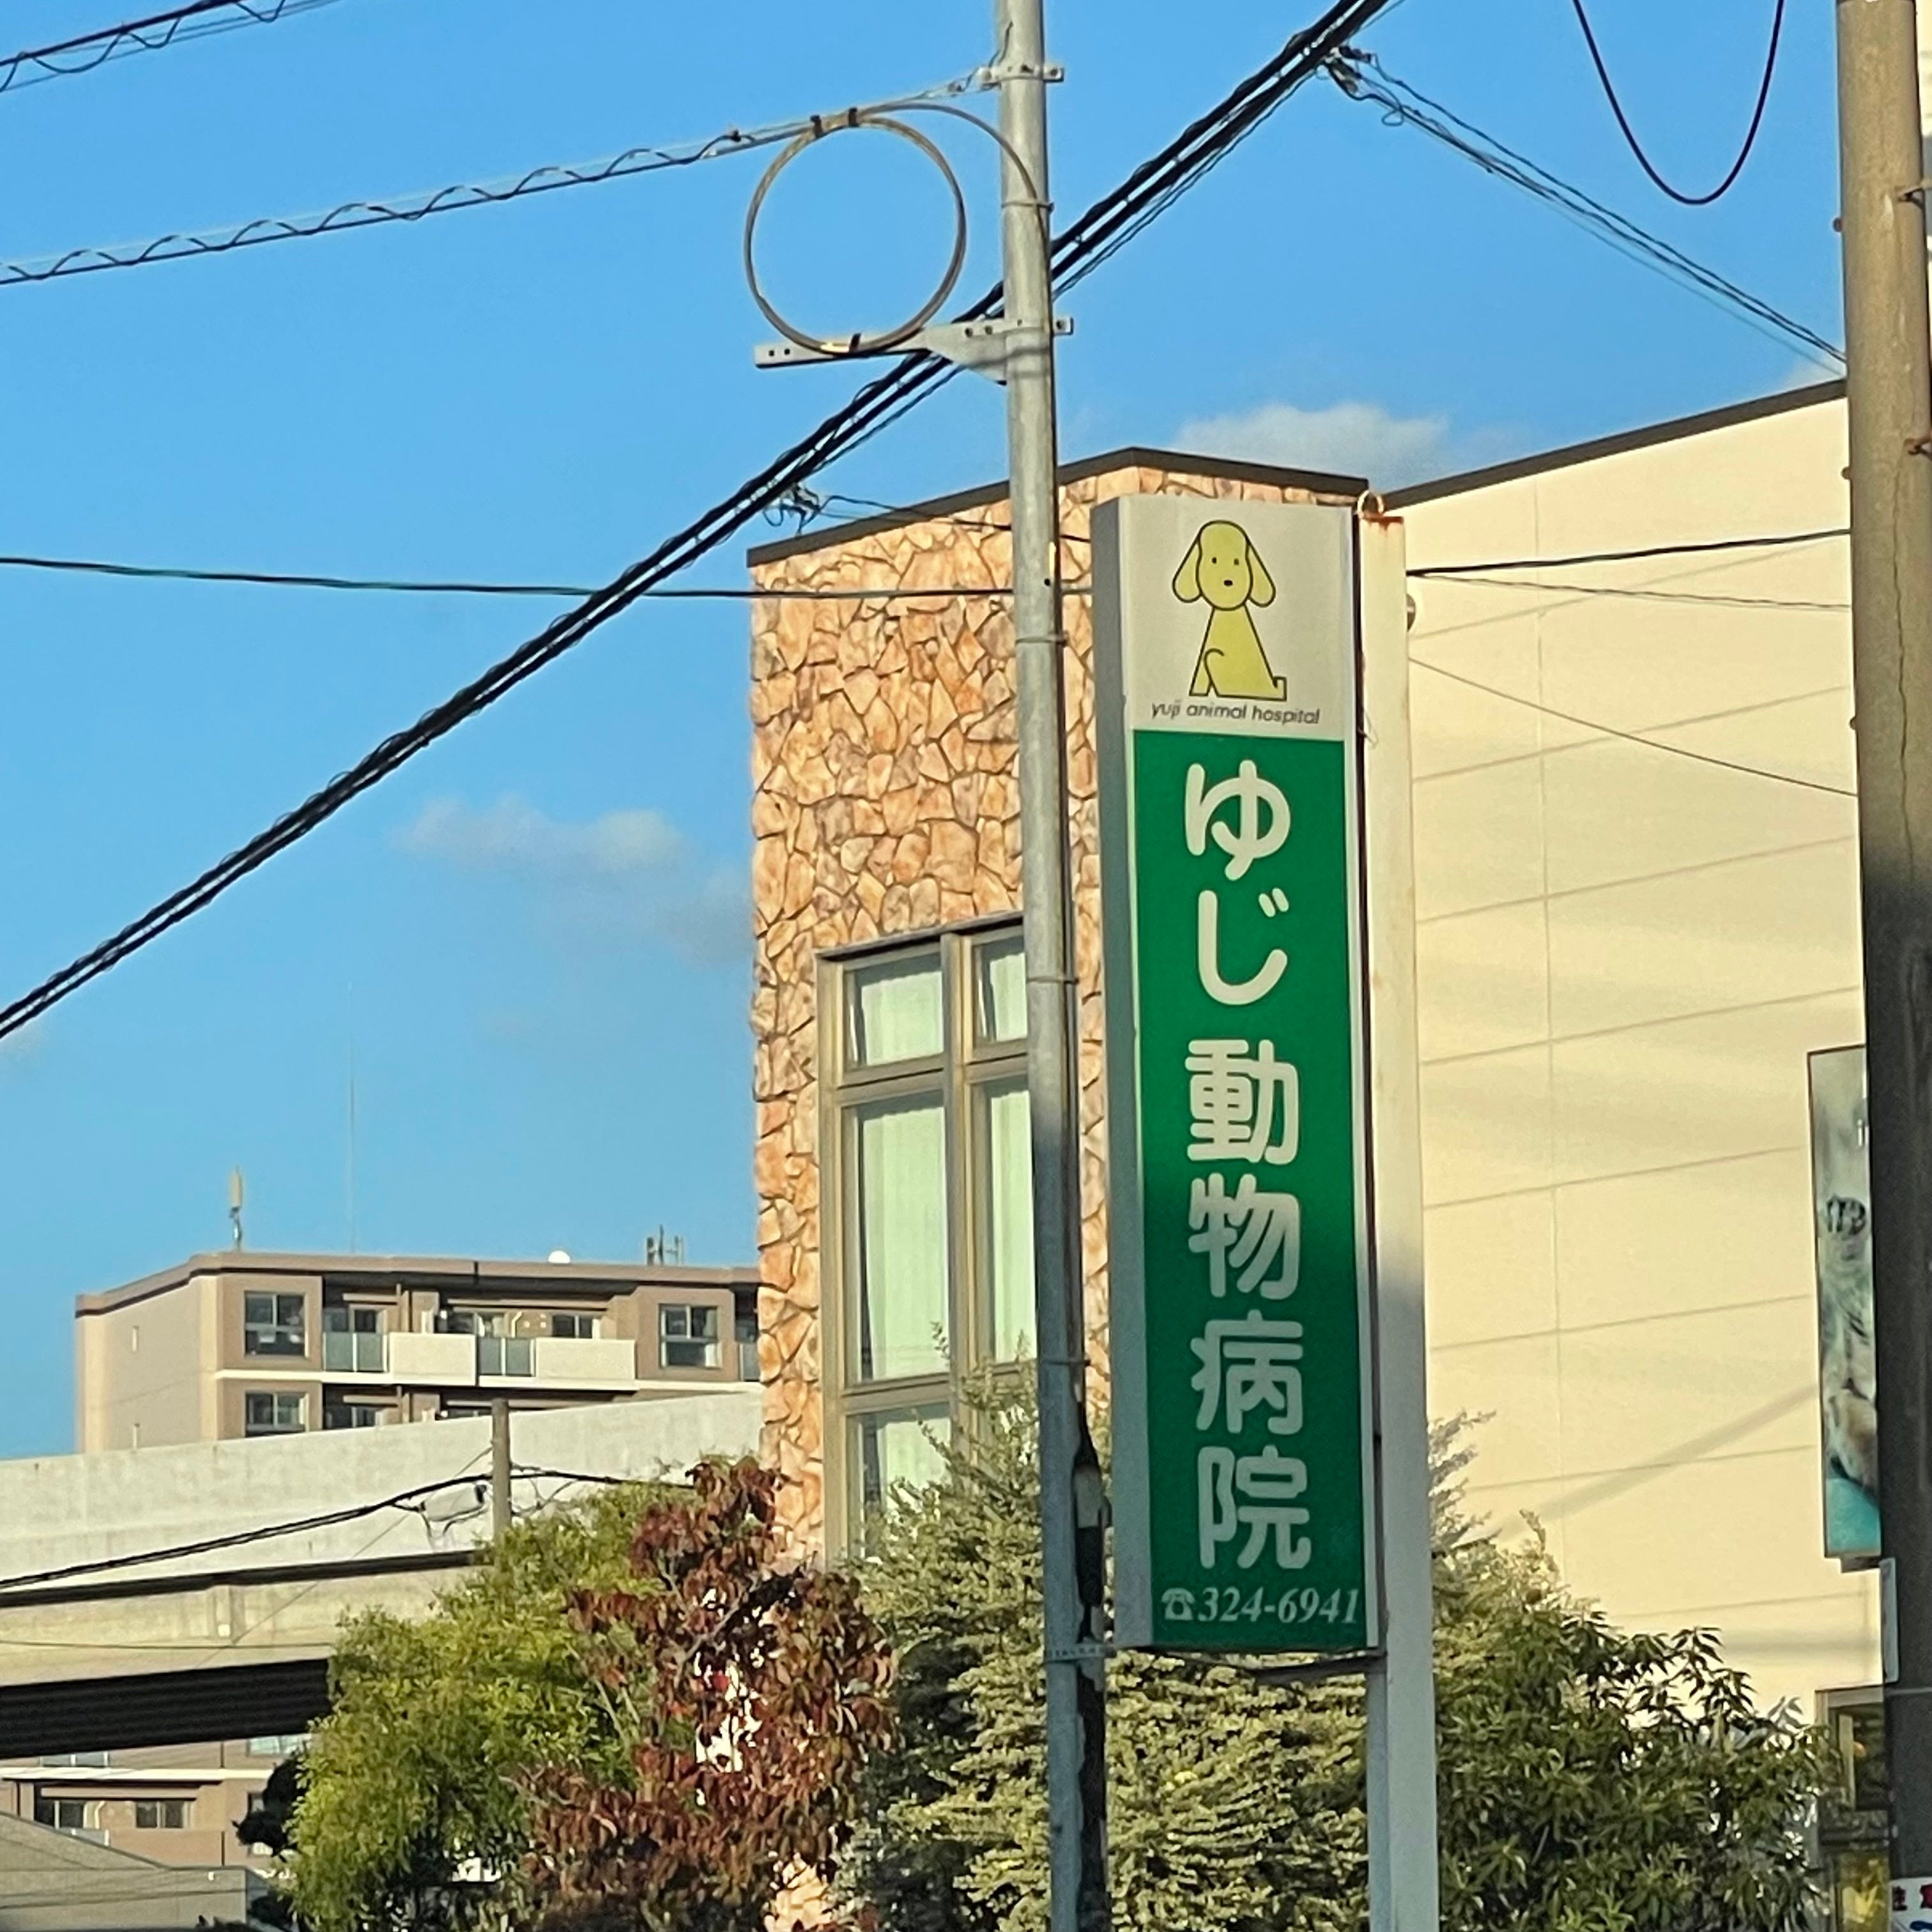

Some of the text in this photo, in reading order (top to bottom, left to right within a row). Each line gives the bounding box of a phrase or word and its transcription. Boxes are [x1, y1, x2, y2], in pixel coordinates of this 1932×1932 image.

[1151, 700, 1320, 724] yuji animal hospital
[1184, 759, 1312, 1568] ゆじ動物病院
[1197, 1586, 1359, 1623] 324-6941
